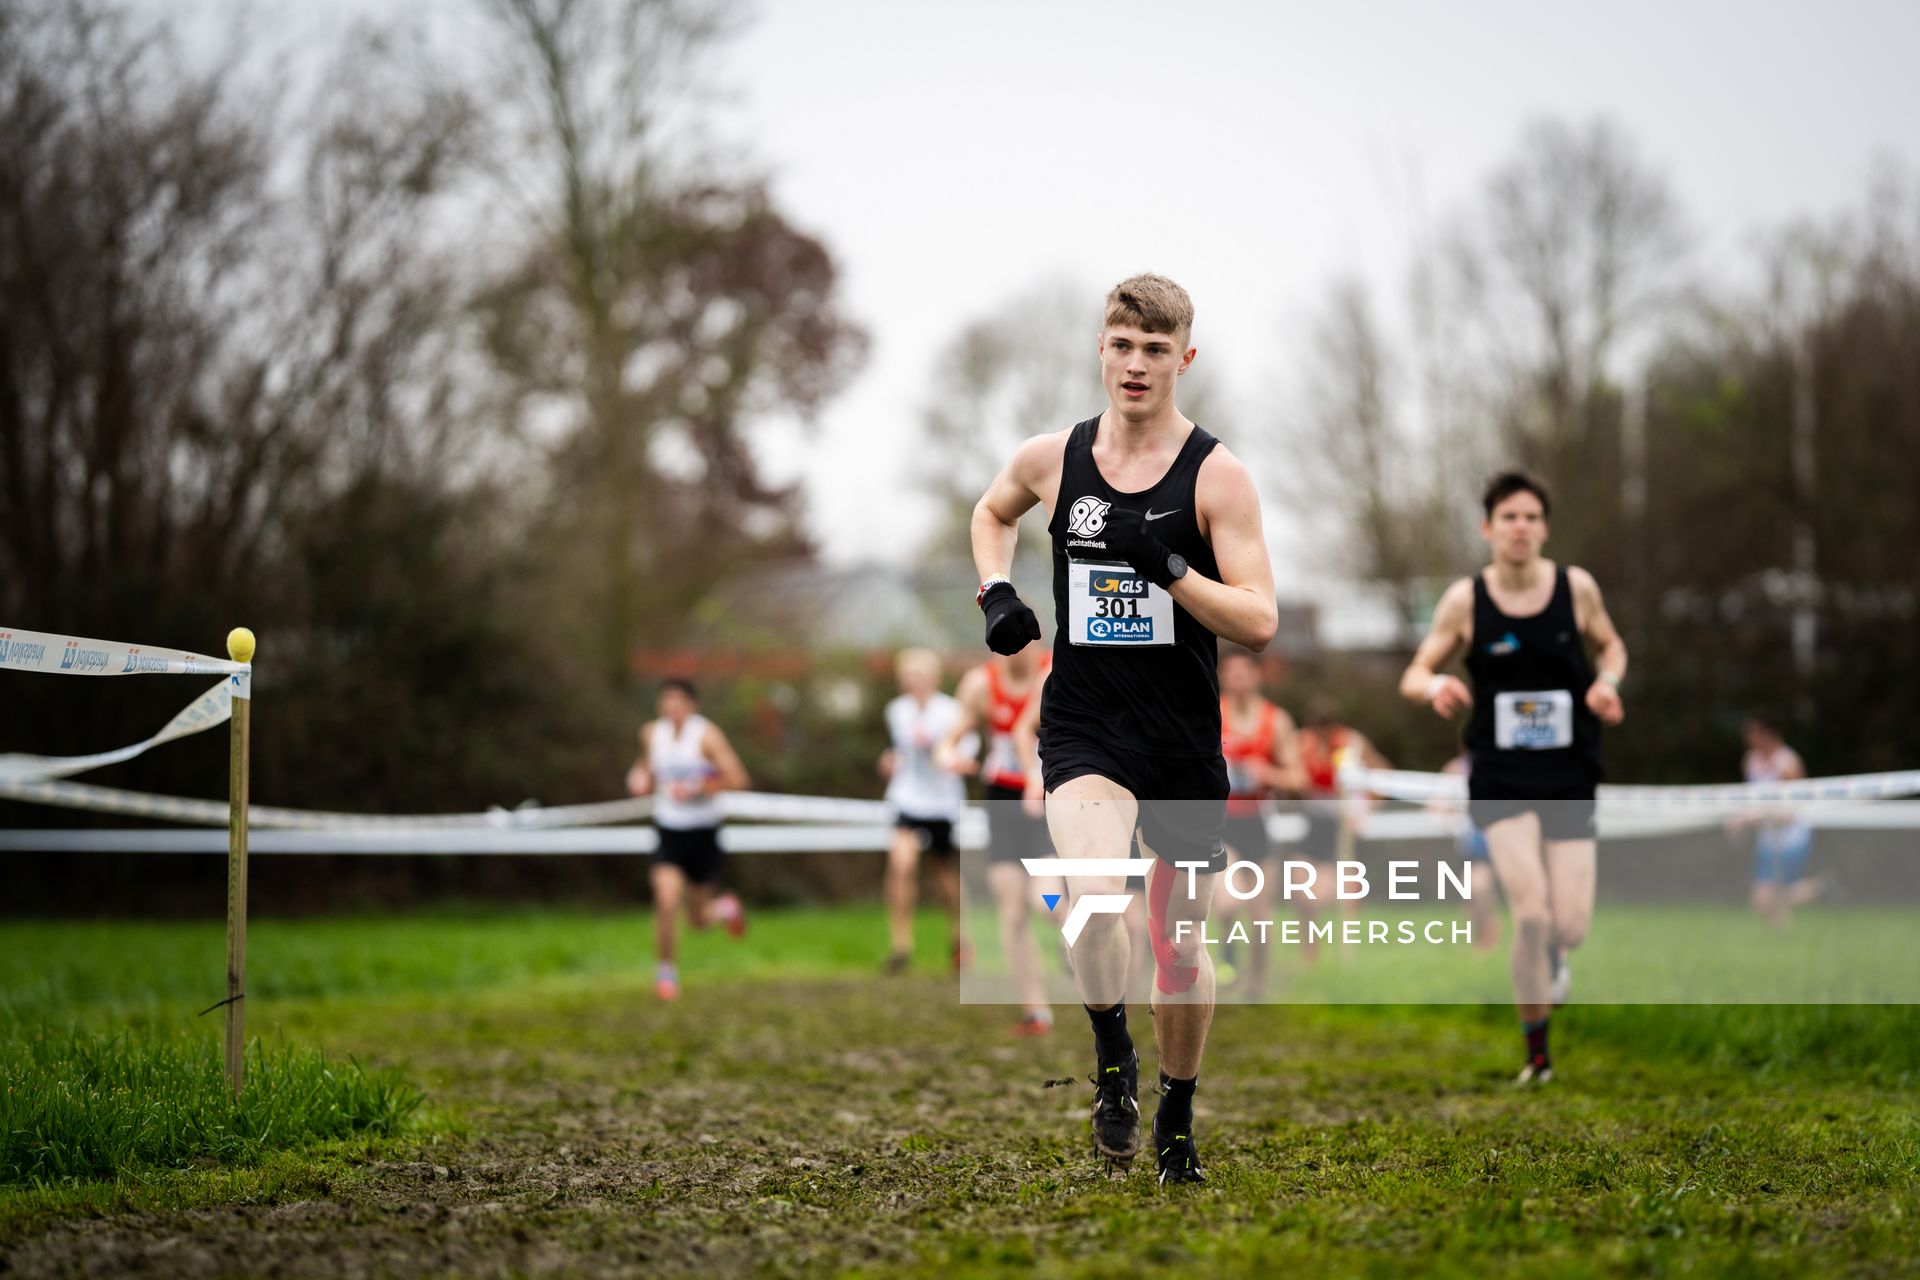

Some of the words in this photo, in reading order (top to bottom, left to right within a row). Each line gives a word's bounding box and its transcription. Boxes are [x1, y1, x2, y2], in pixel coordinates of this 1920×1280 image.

[1072, 501, 1108, 533] 96
[1067, 539, 1107, 550] Leichtathletik
[1118, 580, 1144, 594] GLS
[1095, 597, 1142, 618] 301
[1113, 622, 1151, 633] PLAN
